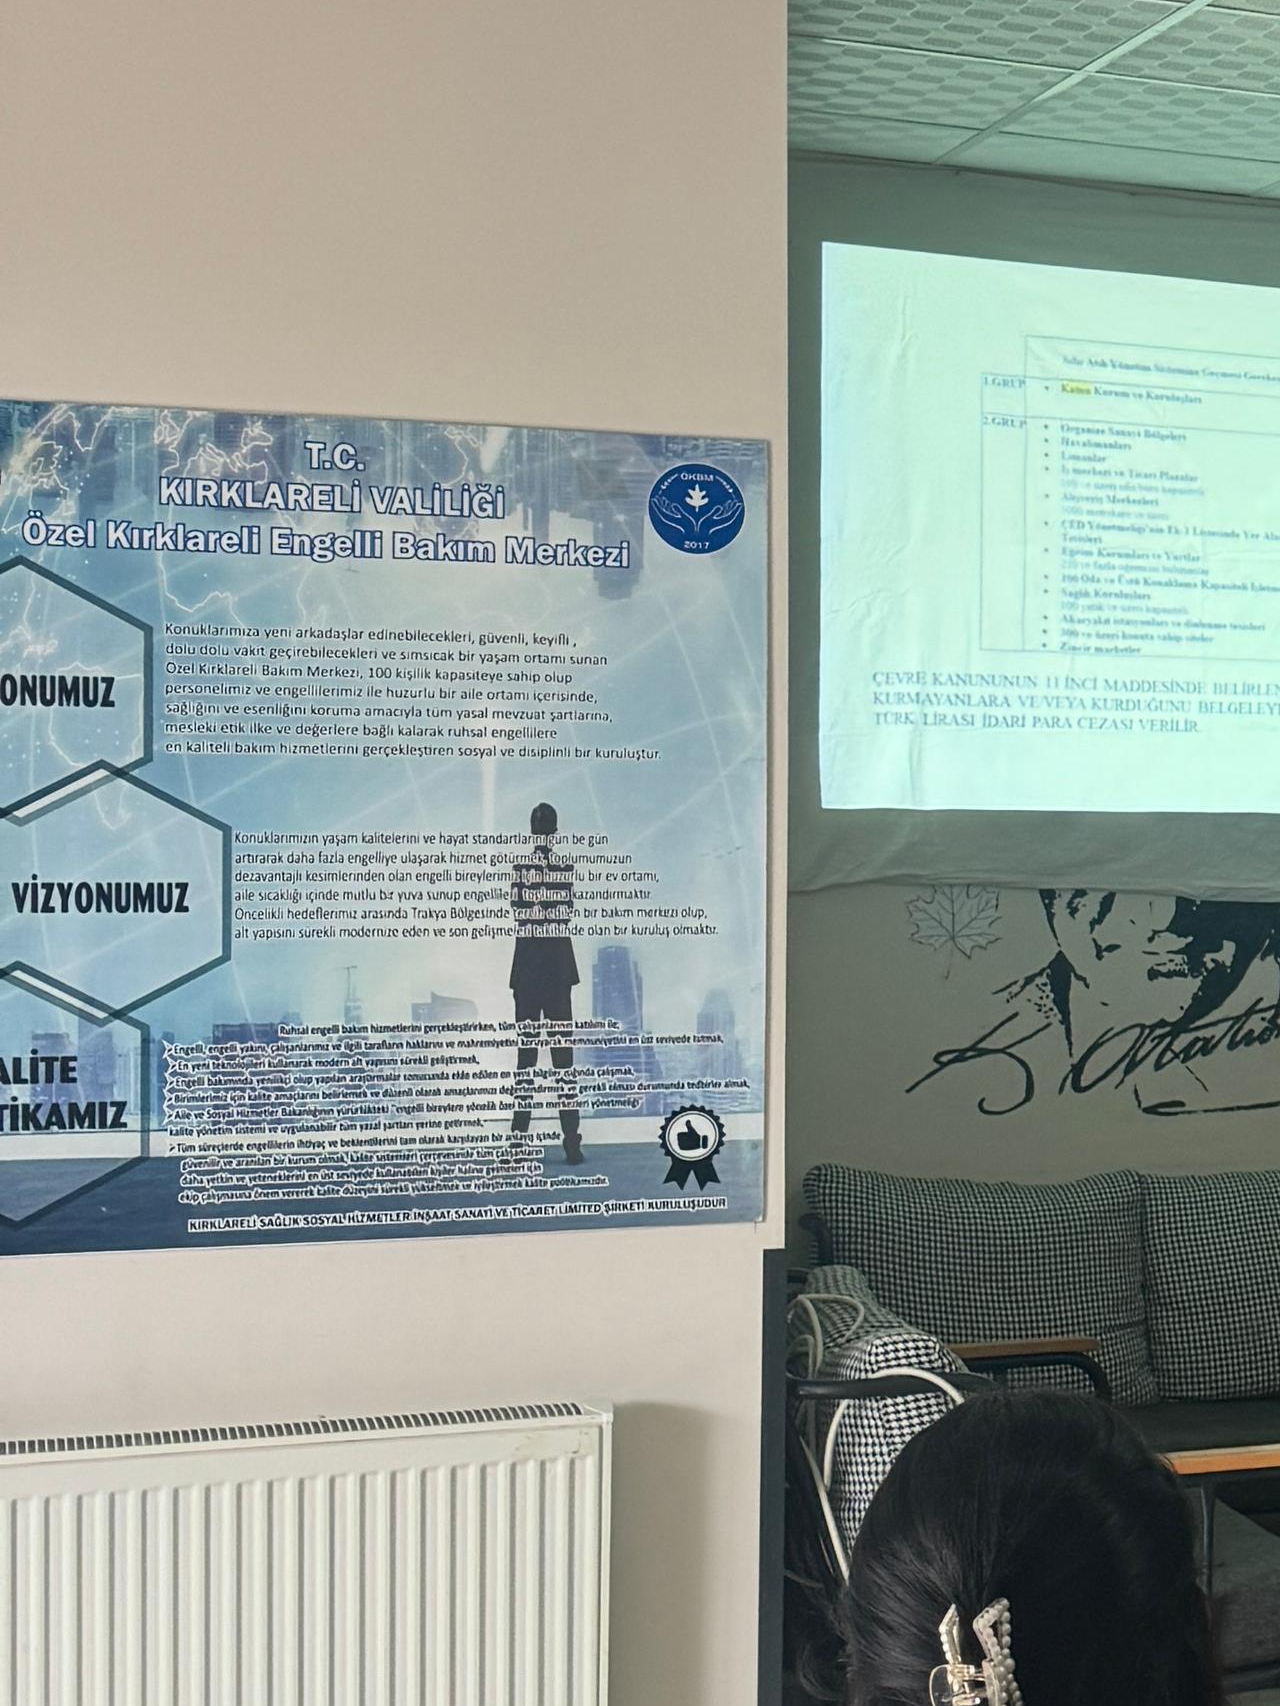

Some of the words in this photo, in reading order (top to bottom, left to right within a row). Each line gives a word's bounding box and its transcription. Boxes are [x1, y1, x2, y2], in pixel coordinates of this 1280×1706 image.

[305, 441, 366, 471] T.C.
[159, 479, 362, 514] KIRKLARELİ
[368, 483, 505, 519] VALİLİĞİ
[22, 510, 96, 548] Özel
[106, 520, 261, 555] Kırklareli
[270, 529, 383, 562] Engelli
[392, 531, 496, 563] Bakım
[505, 536, 630, 568] Merkezi
[683, 540, 710, 550] 2017
[11, 874, 190, 914] VİZYONUMUZ
